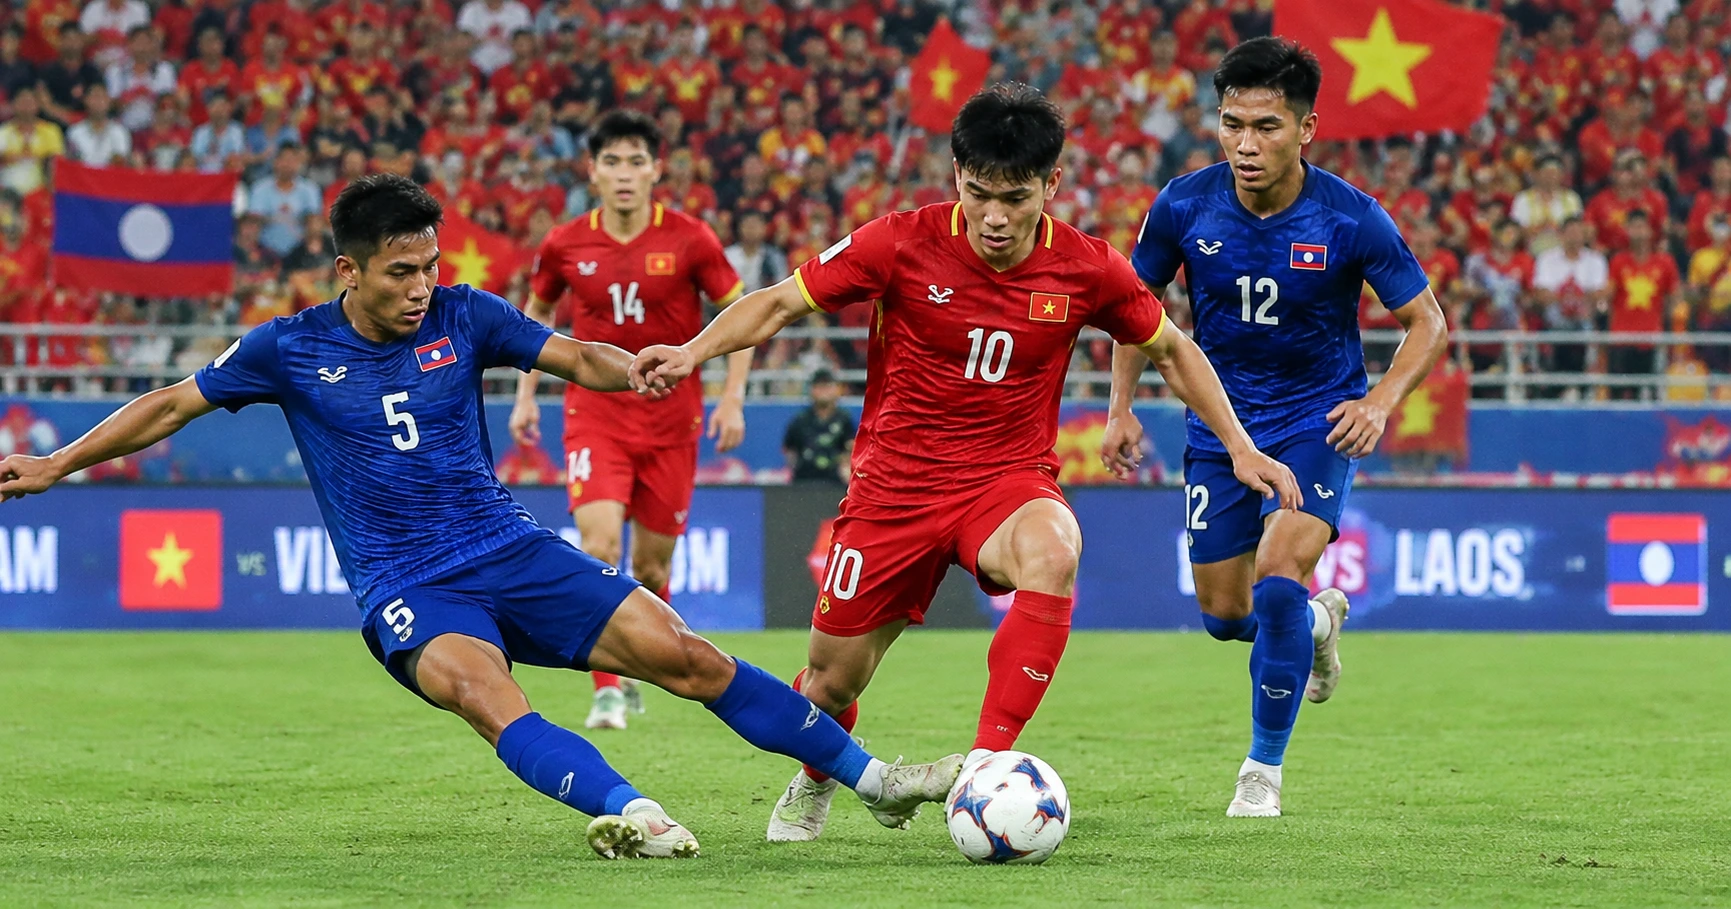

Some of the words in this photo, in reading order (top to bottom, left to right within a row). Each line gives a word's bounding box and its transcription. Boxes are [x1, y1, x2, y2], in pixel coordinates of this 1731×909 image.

[608, 281, 645, 325] 14
[1236, 275, 1279, 325] 12
[964, 328, 1014, 382] 10
[381, 391, 420, 451] 5
[568, 447, 592, 482] 14
[1184, 484, 1209, 530] 12
[823, 542, 864, 600] 10
[1314, 541, 1365, 593] VS
[1395, 528, 1526, 597] LAOS
[382, 597, 416, 635] 5
